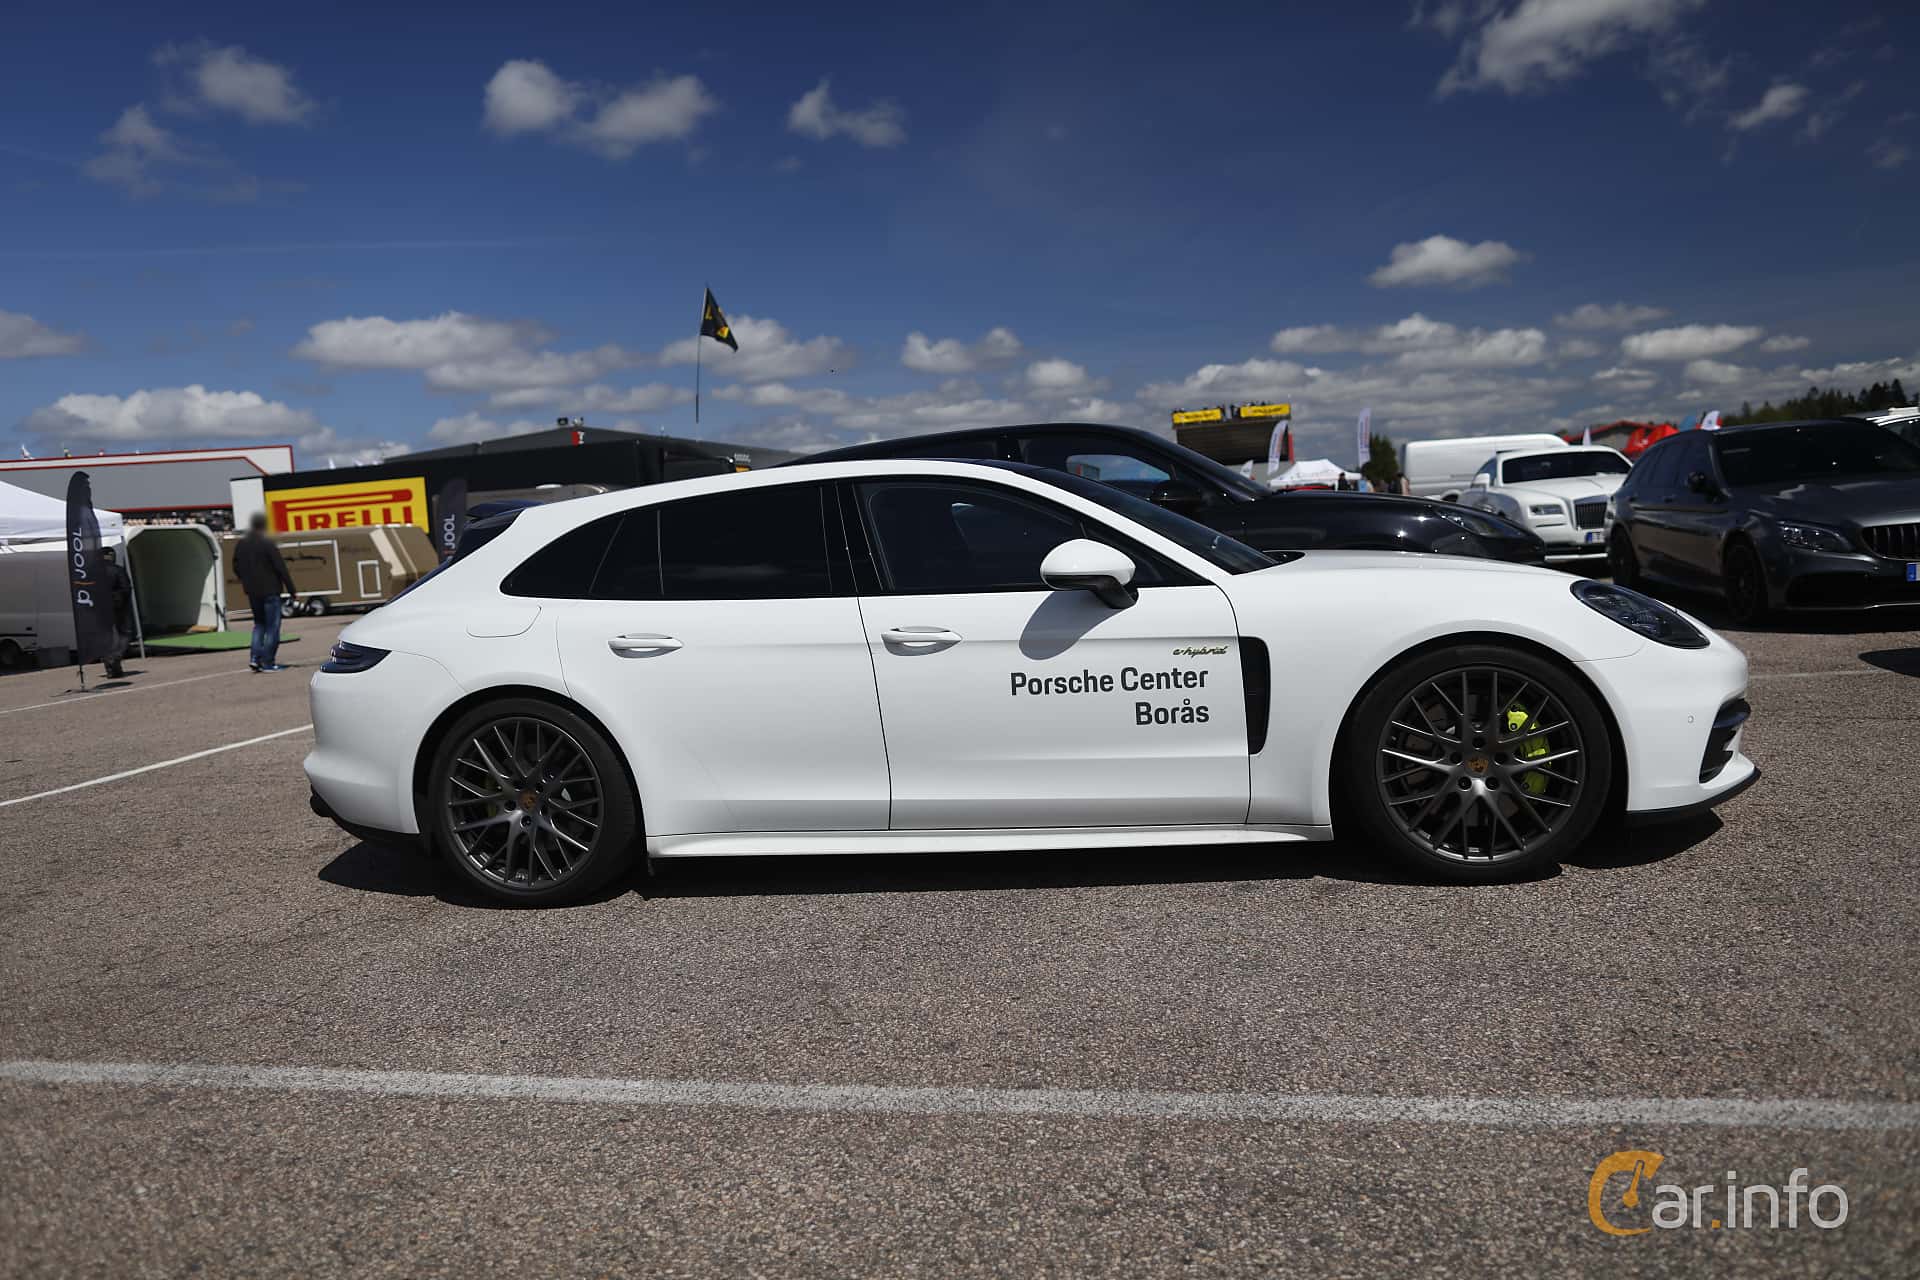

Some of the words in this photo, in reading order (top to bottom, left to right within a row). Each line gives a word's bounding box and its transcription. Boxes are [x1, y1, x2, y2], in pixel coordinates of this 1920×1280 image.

[443, 513, 456, 549] JOOL
[72, 527, 87, 579] JOOL
[1010, 669, 1114, 696] Porsche
[1120, 667, 1208, 691] Center
[1135, 699, 1210, 725] Borås
